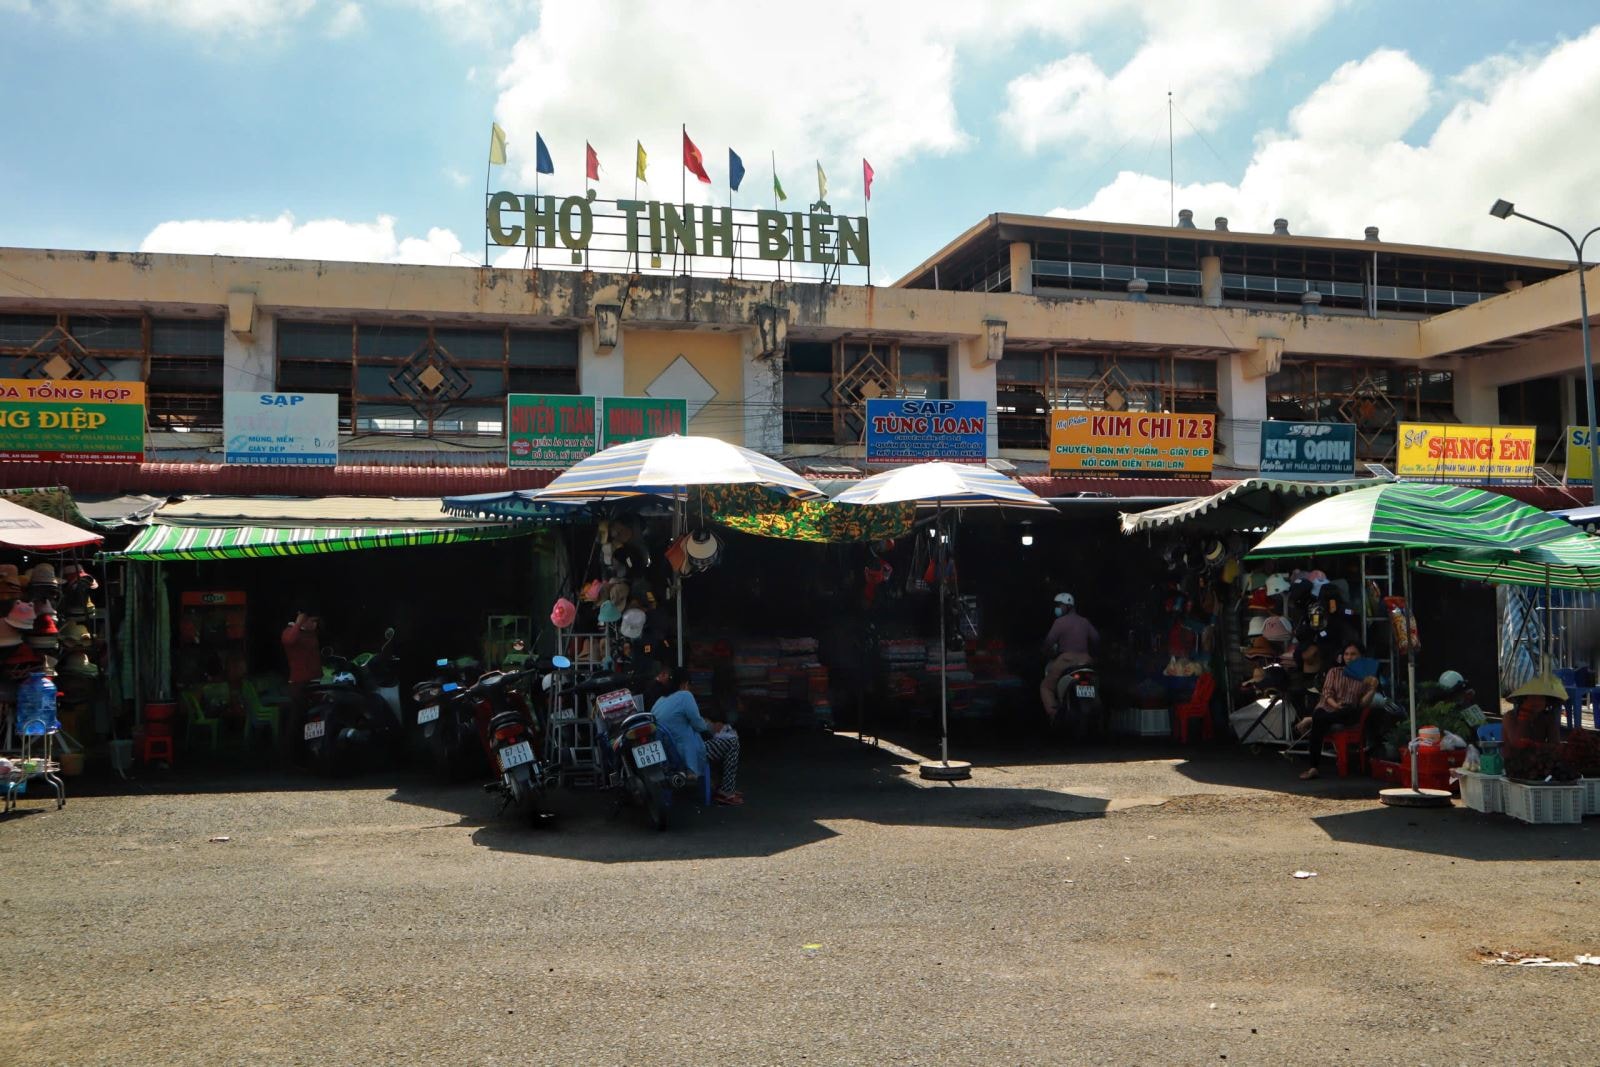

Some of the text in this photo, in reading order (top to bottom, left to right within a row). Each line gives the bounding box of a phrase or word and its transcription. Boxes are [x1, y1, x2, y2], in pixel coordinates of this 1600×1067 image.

[487, 188, 870, 268] CHỢ TỊNH BIÊN
[27, 381, 83, 399] TỔNG
[90, 388, 131, 402] HỢP
[260, 394, 304, 407] SẠP
[903, 401, 955, 417] SẠP
[38, 407, 107, 432] ĐIỆP
[872, 412, 985, 434] TÙNG LOAN
[1092, 416, 1213, 439] KIM CHI 123
[1428, 437, 1494, 460] SANG
[1167, 459, 1185, 469] LAN
[507, 752, 528, 765] 1211
[637, 743, 659, 757] 67-L2
[640, 752, 661, 766] 0817
